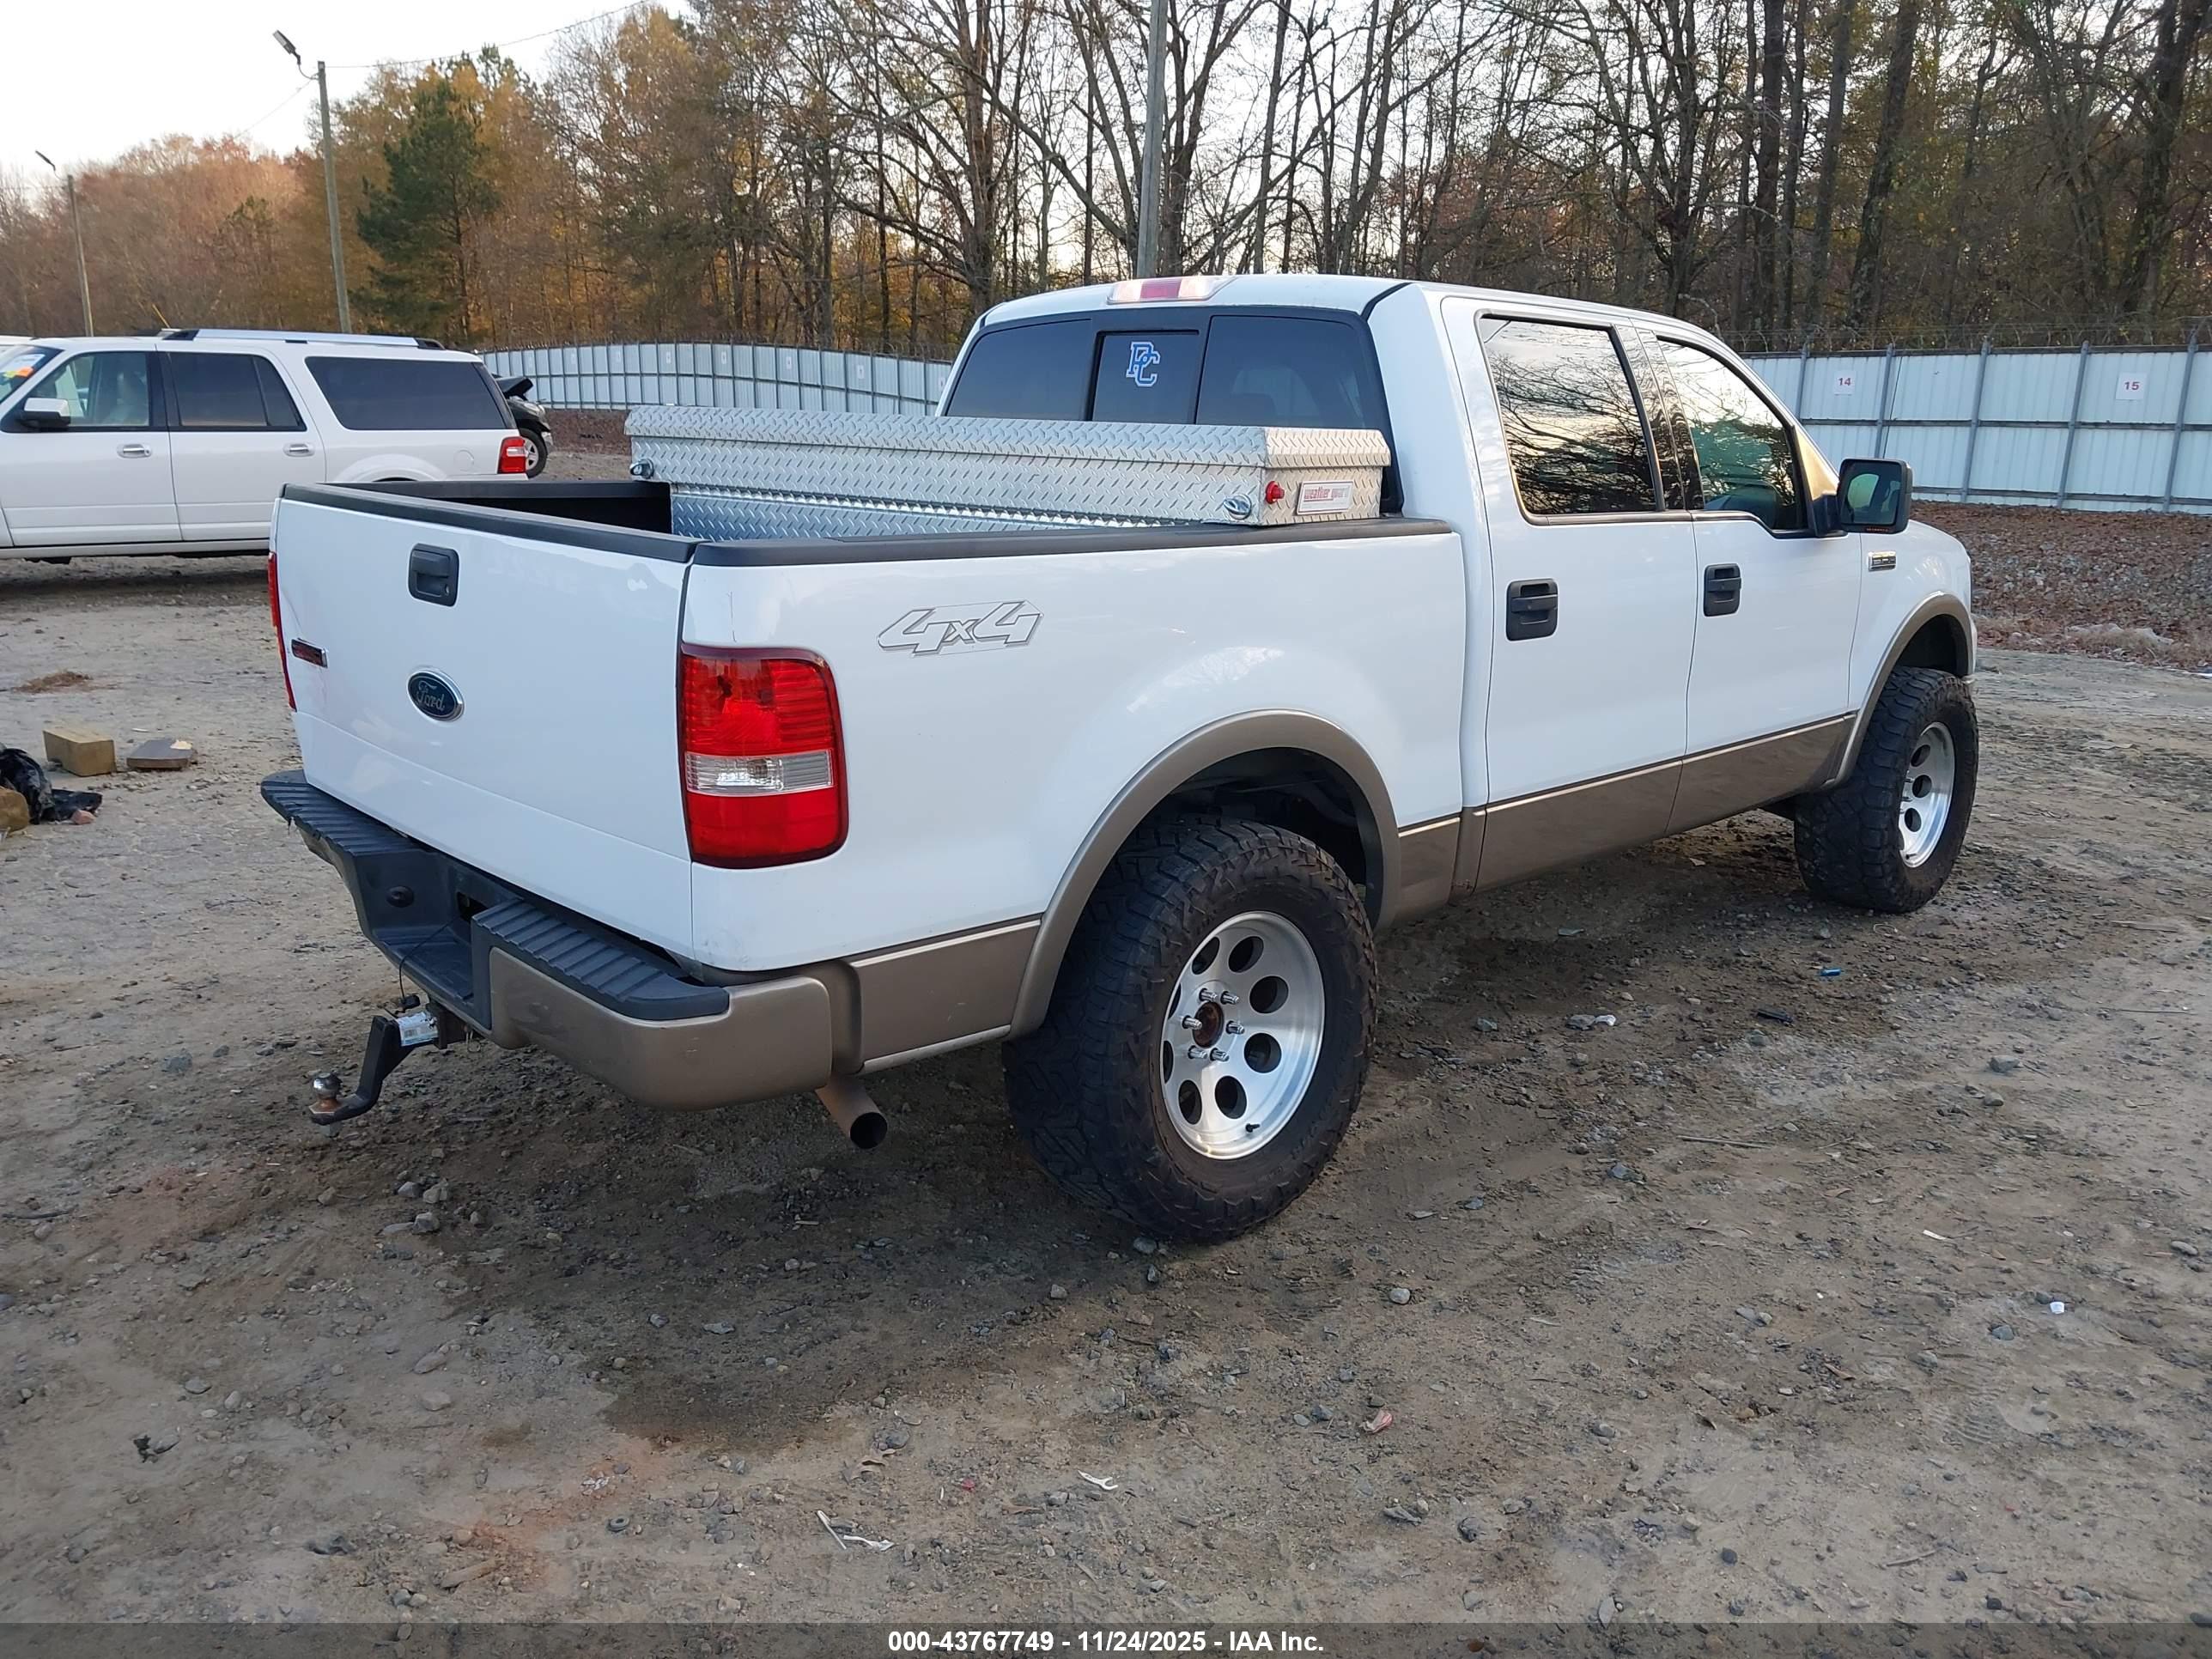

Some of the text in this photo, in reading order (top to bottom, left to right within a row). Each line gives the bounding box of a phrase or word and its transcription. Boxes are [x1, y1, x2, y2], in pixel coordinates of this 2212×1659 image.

[1838, 377, 1851, 386] 14
[2124, 381, 2141, 391] 15
[878, 599, 1042, 656] 4x4
[416, 679, 447, 711] Ford
